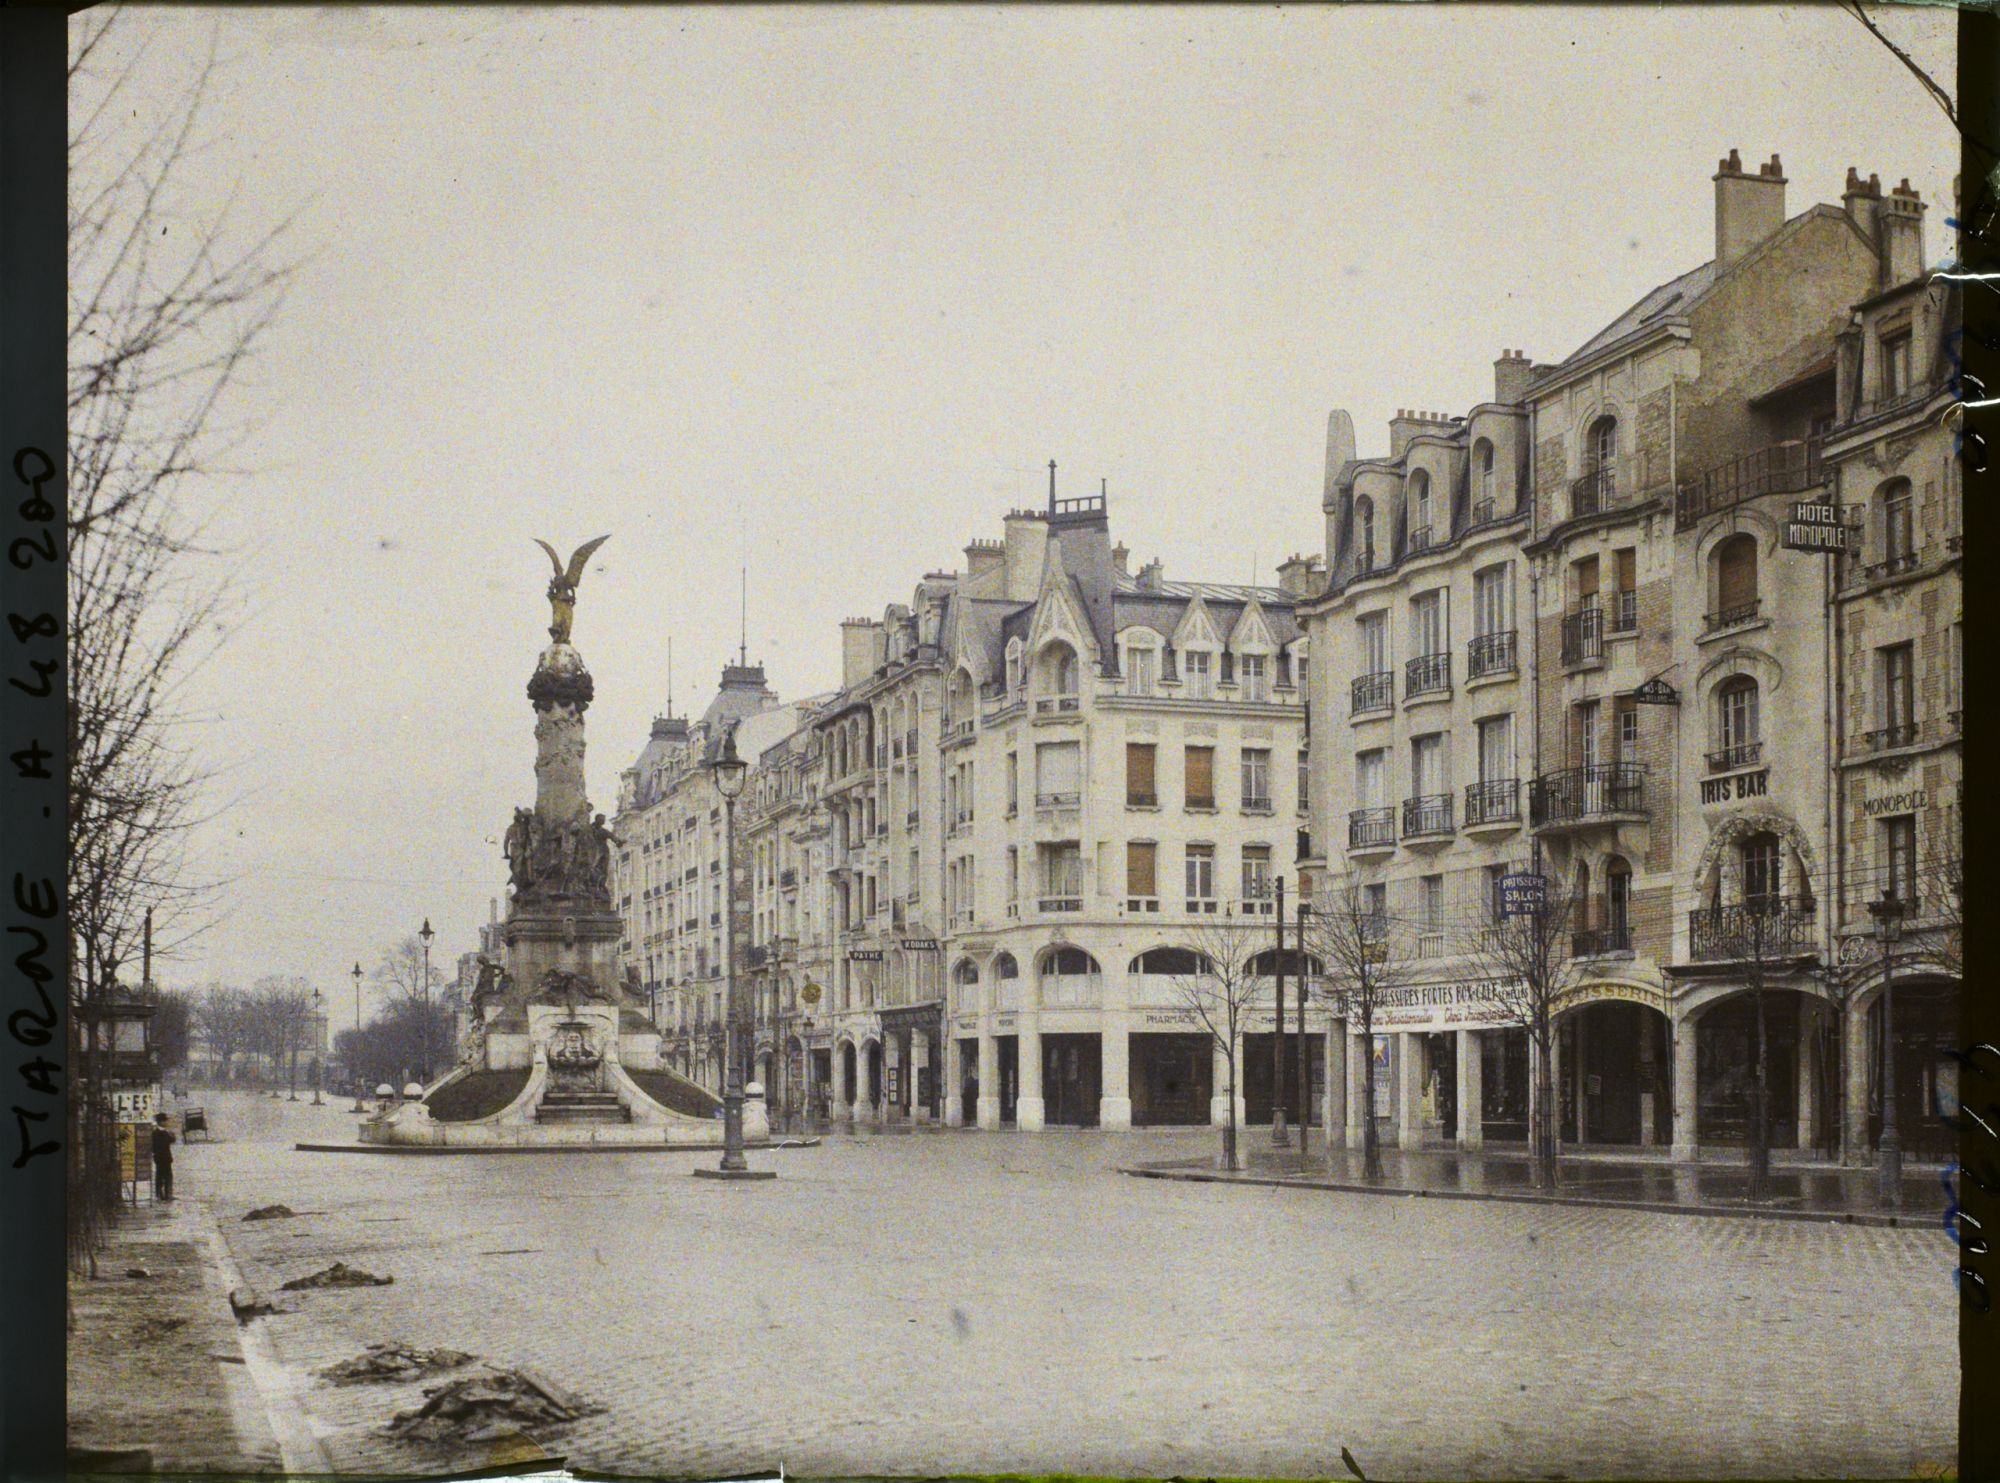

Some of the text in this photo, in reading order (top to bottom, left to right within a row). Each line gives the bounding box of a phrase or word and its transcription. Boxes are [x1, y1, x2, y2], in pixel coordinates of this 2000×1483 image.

[9, 445, 57, 570] 200
[1797, 503, 1837, 523] HOTEL
[1789, 524, 1845, 548] MONOPOLE
[14, 739, 52, 779] A
[1701, 773, 1768, 804] IRIS BAR
[1863, 790, 1929, 816] MONOPOLE
[1505, 890, 1544, 902] SALON
[904, 940, 935, 949] KODAKS
[1422, 986, 1454, 1005] FORTES
[8, 872, 60, 1170] MARNE
